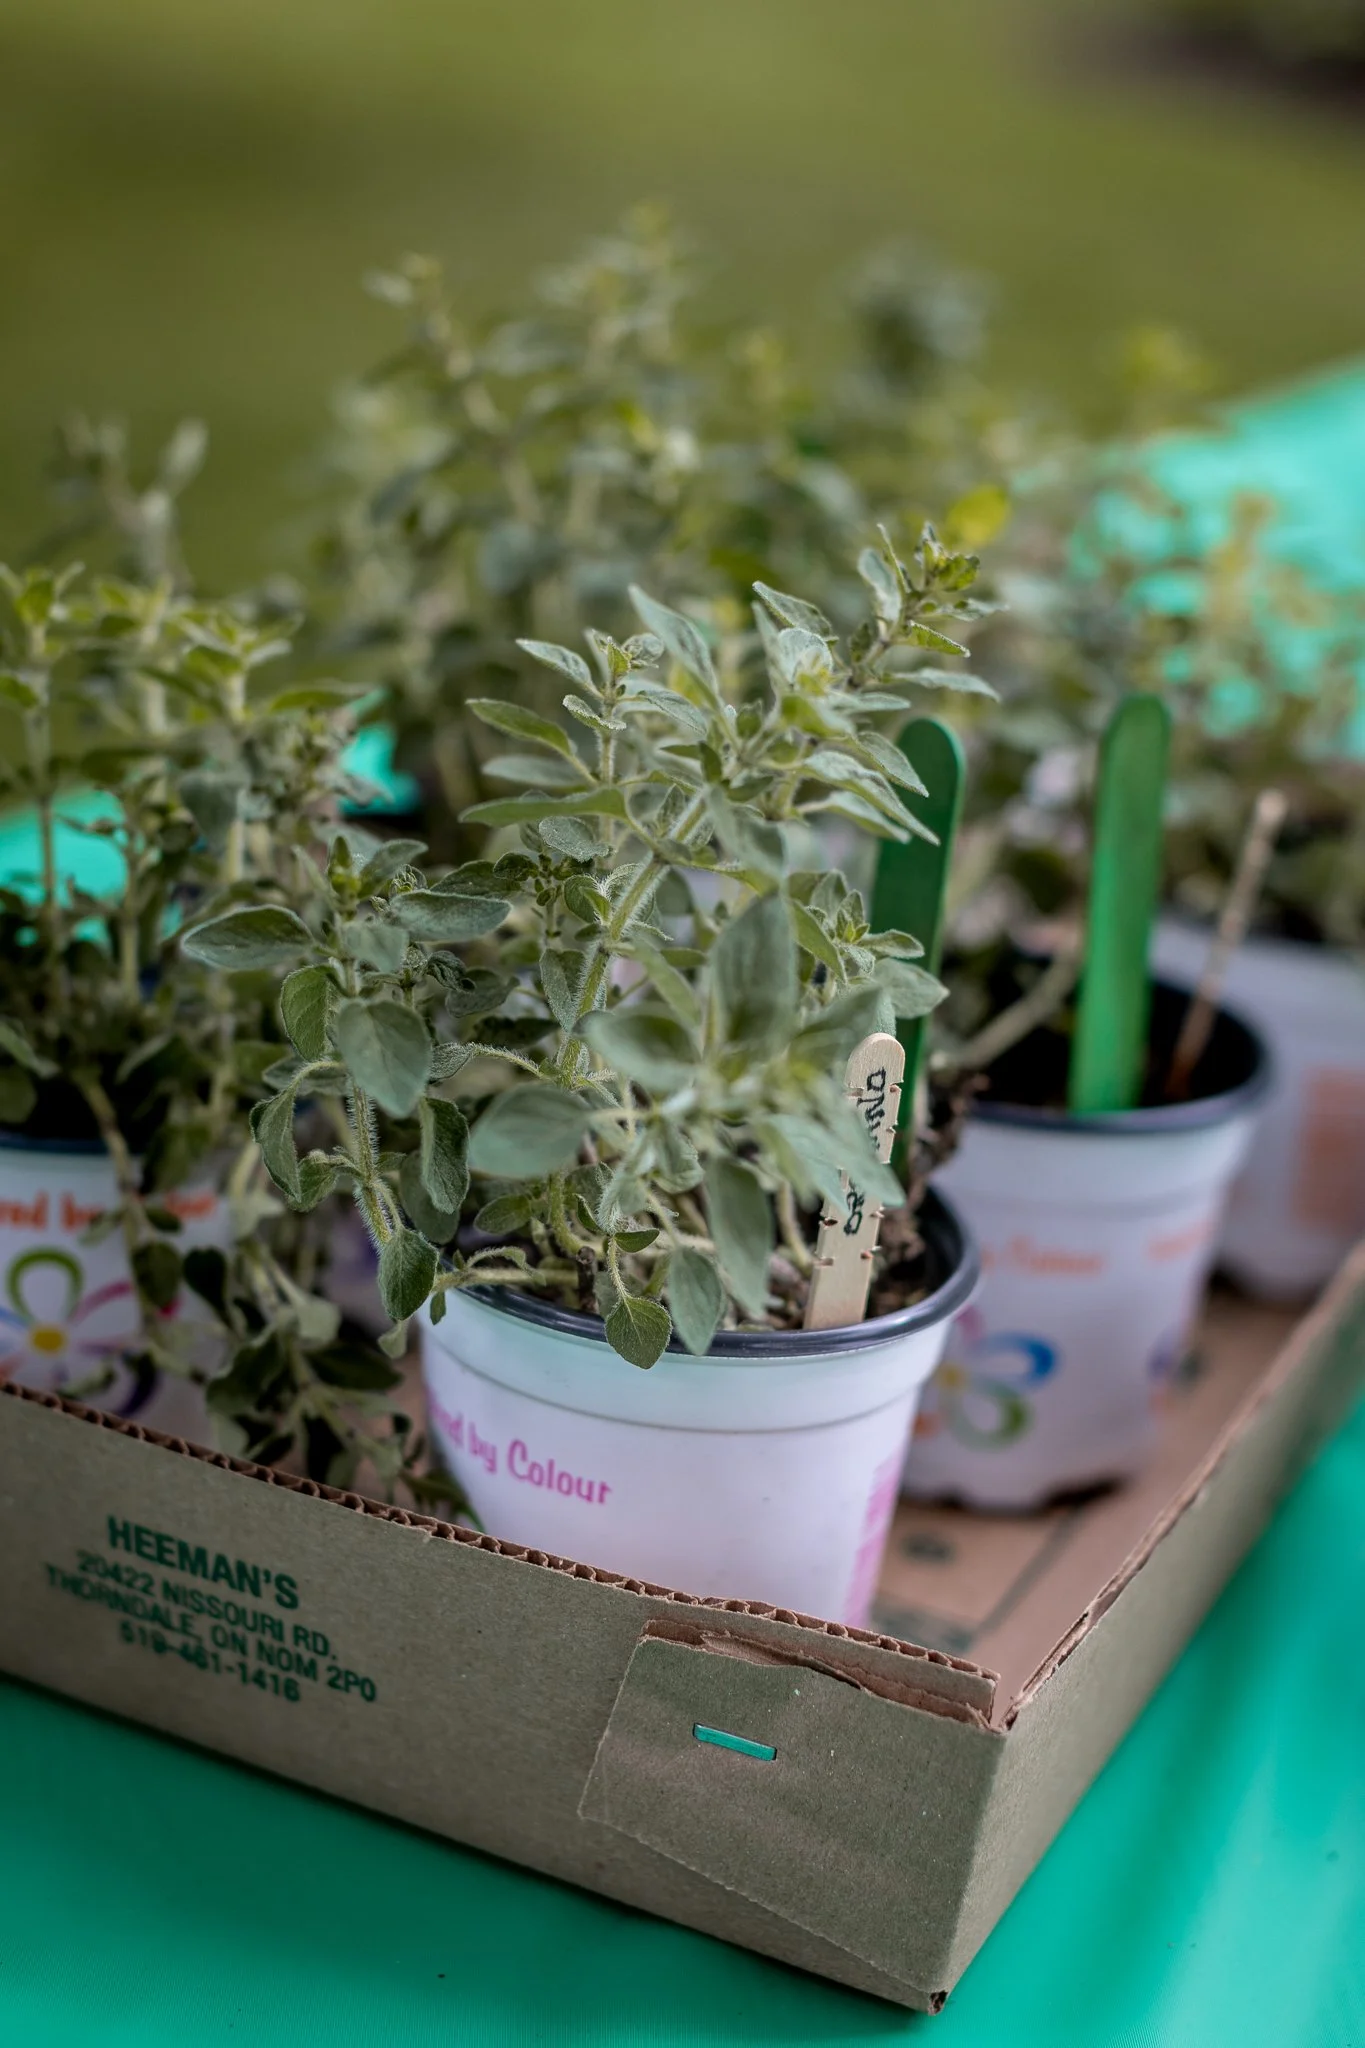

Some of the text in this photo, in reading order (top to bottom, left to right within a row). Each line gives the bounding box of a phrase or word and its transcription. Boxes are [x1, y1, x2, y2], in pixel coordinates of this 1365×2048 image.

[506, 1437, 612, 1504] Colour
[107, 1514, 299, 1610] HEEMAN'S
[76, 1550, 338, 1660] 20422 NISSOURI RD.
[211, 1624, 248, 1656] ON
